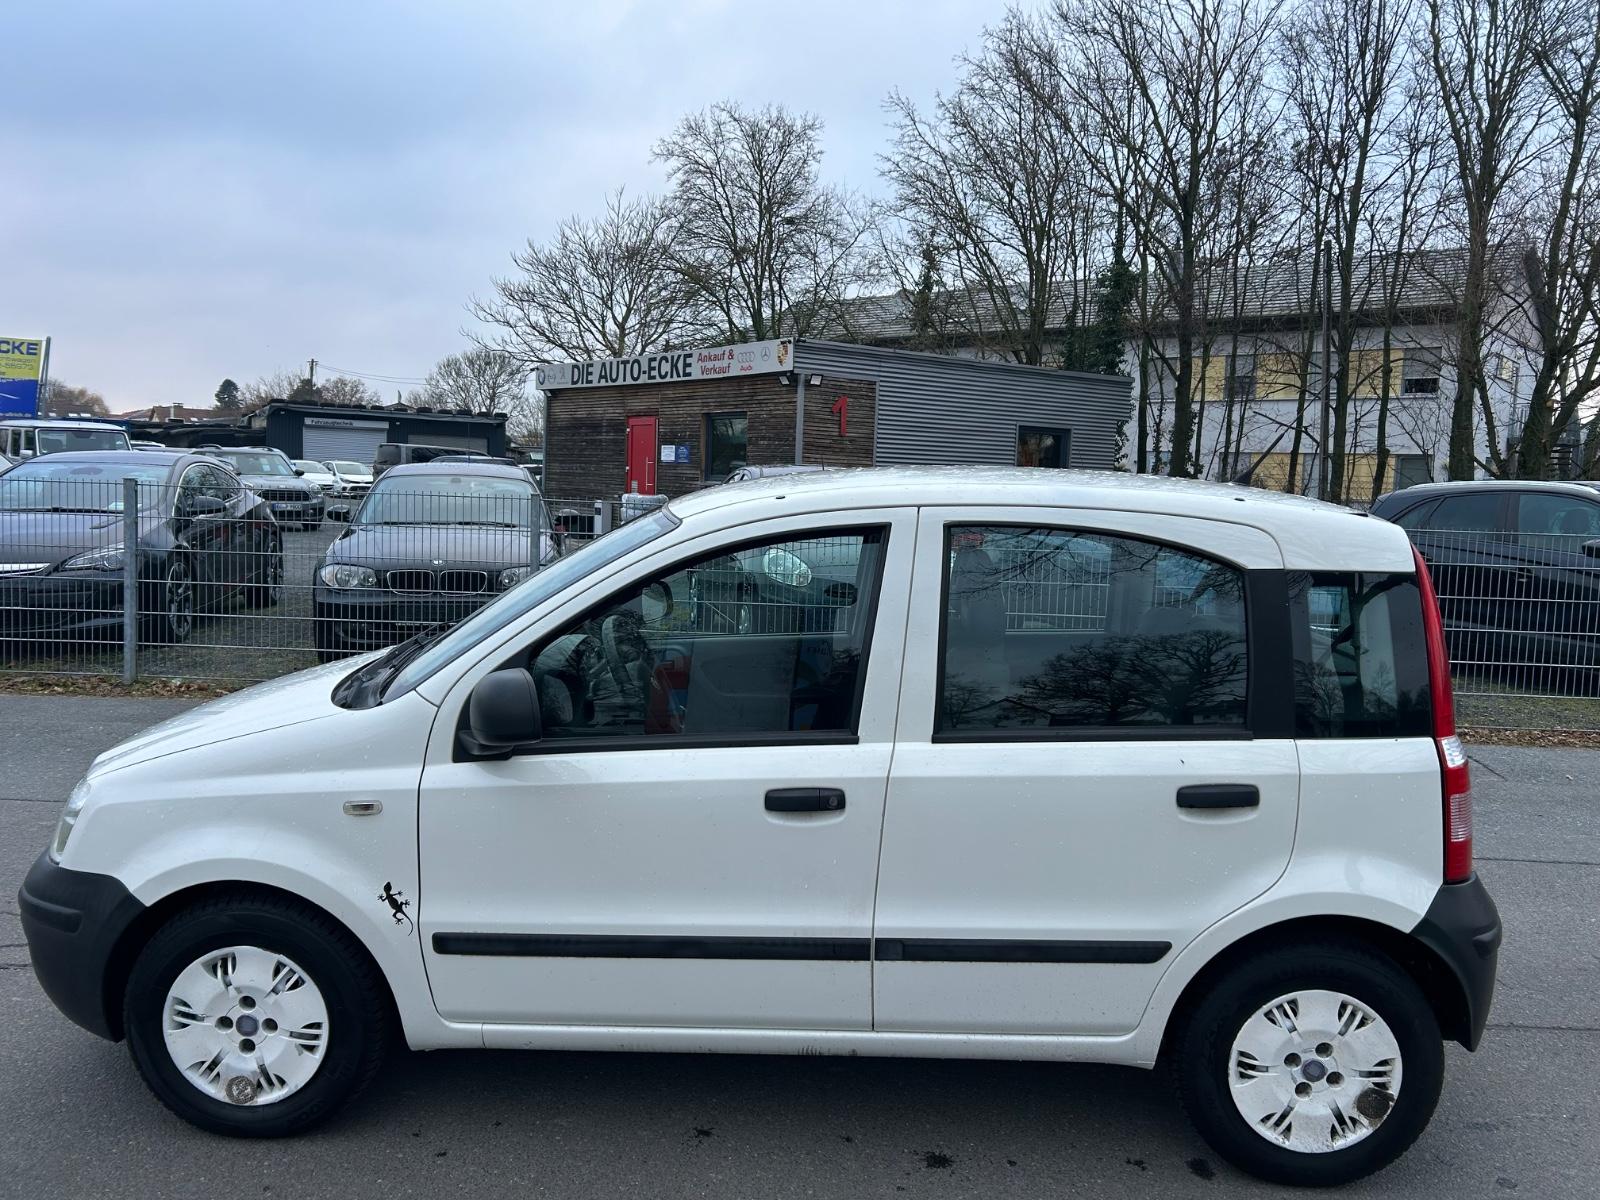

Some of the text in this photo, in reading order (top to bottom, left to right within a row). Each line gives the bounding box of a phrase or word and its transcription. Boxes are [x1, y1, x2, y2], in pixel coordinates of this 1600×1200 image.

[697, 349, 734, 363] Ankauf &
[571, 353, 693, 385] DIE AUTO-ECKE
[700, 363, 731, 376] Verkauf
[831, 395, 848, 437] 1
